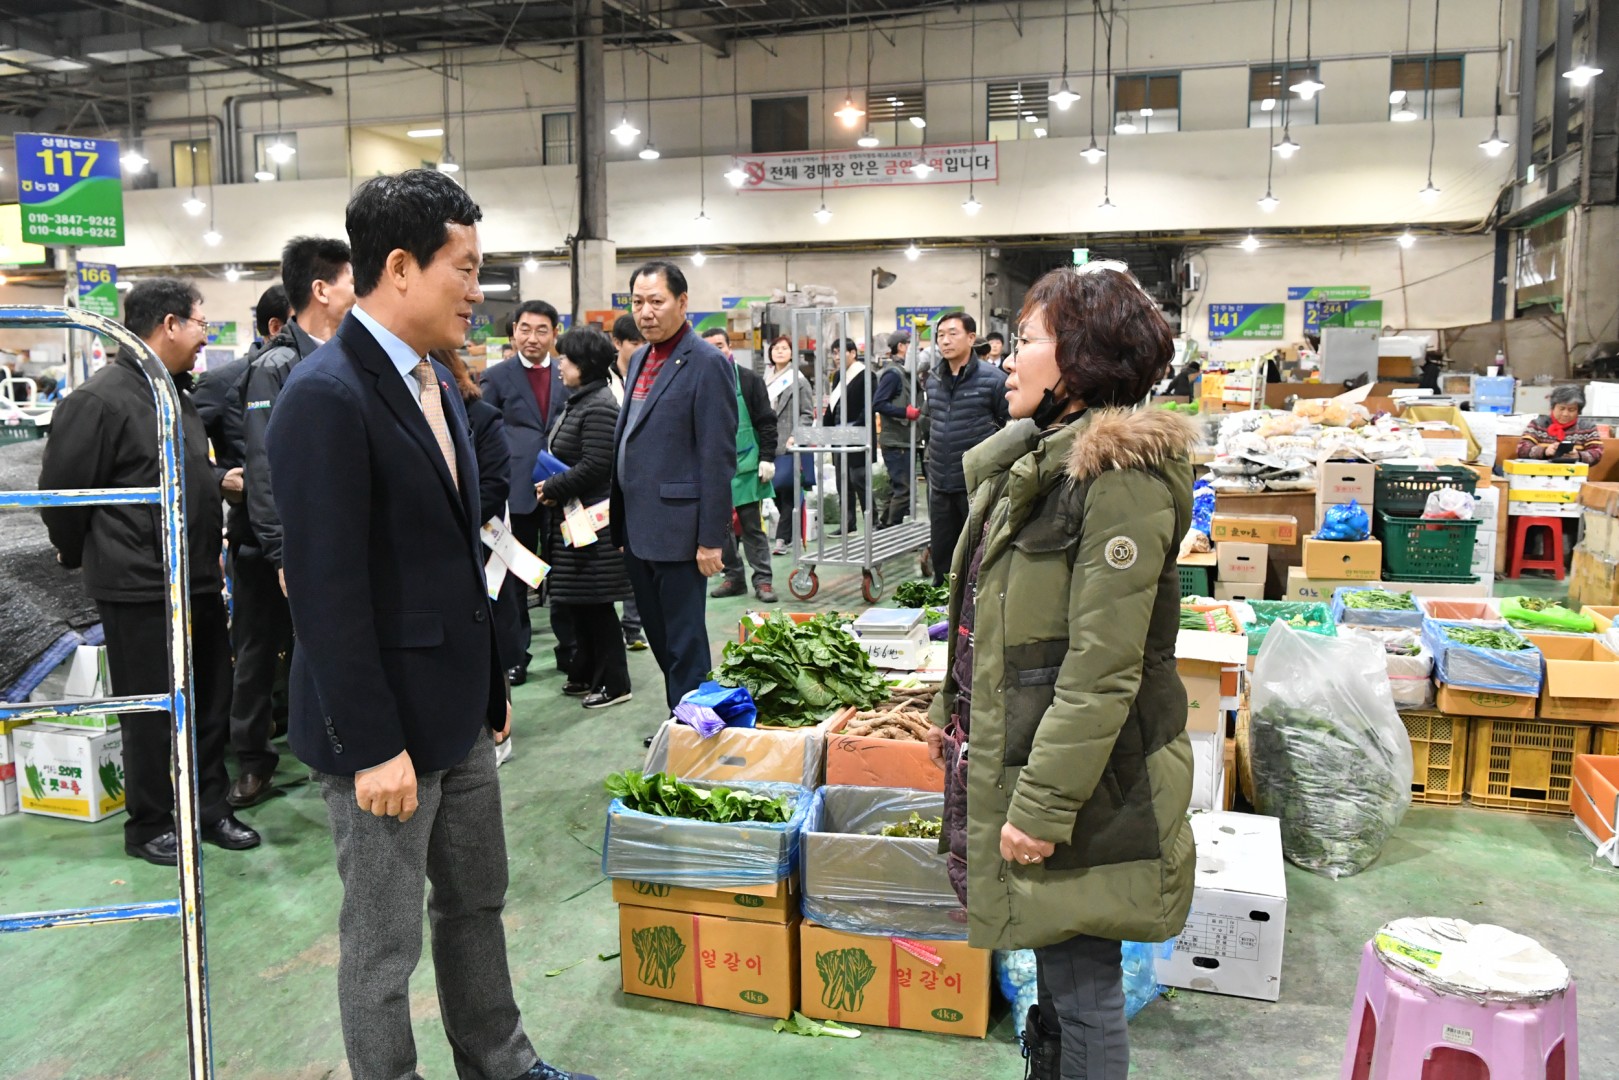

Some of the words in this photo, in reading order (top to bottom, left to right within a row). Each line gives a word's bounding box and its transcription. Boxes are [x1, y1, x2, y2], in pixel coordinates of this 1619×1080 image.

[36, 149, 99, 177] 117
[770, 166, 798, 180] 전체
[803, 162, 845, 179] 경매장
[850, 160, 879, 176] 안은
[884, 155, 990, 175] 금연역입니다
[28, 213, 116, 226] 010-3847-9242
[29, 225, 117, 238] 010-4848-9242
[80, 268, 111, 283] 166
[1323, 305, 1341, 314] 244
[1211, 312, 1238, 327] 141
[739, 894, 760, 907] 4kg
[701, 950, 762, 976] 얼갈이
[896, 968, 962, 994] 얼갈이
[743, 991, 764, 1004] 4kg
[937, 1008, 959, 1022] 4kg
